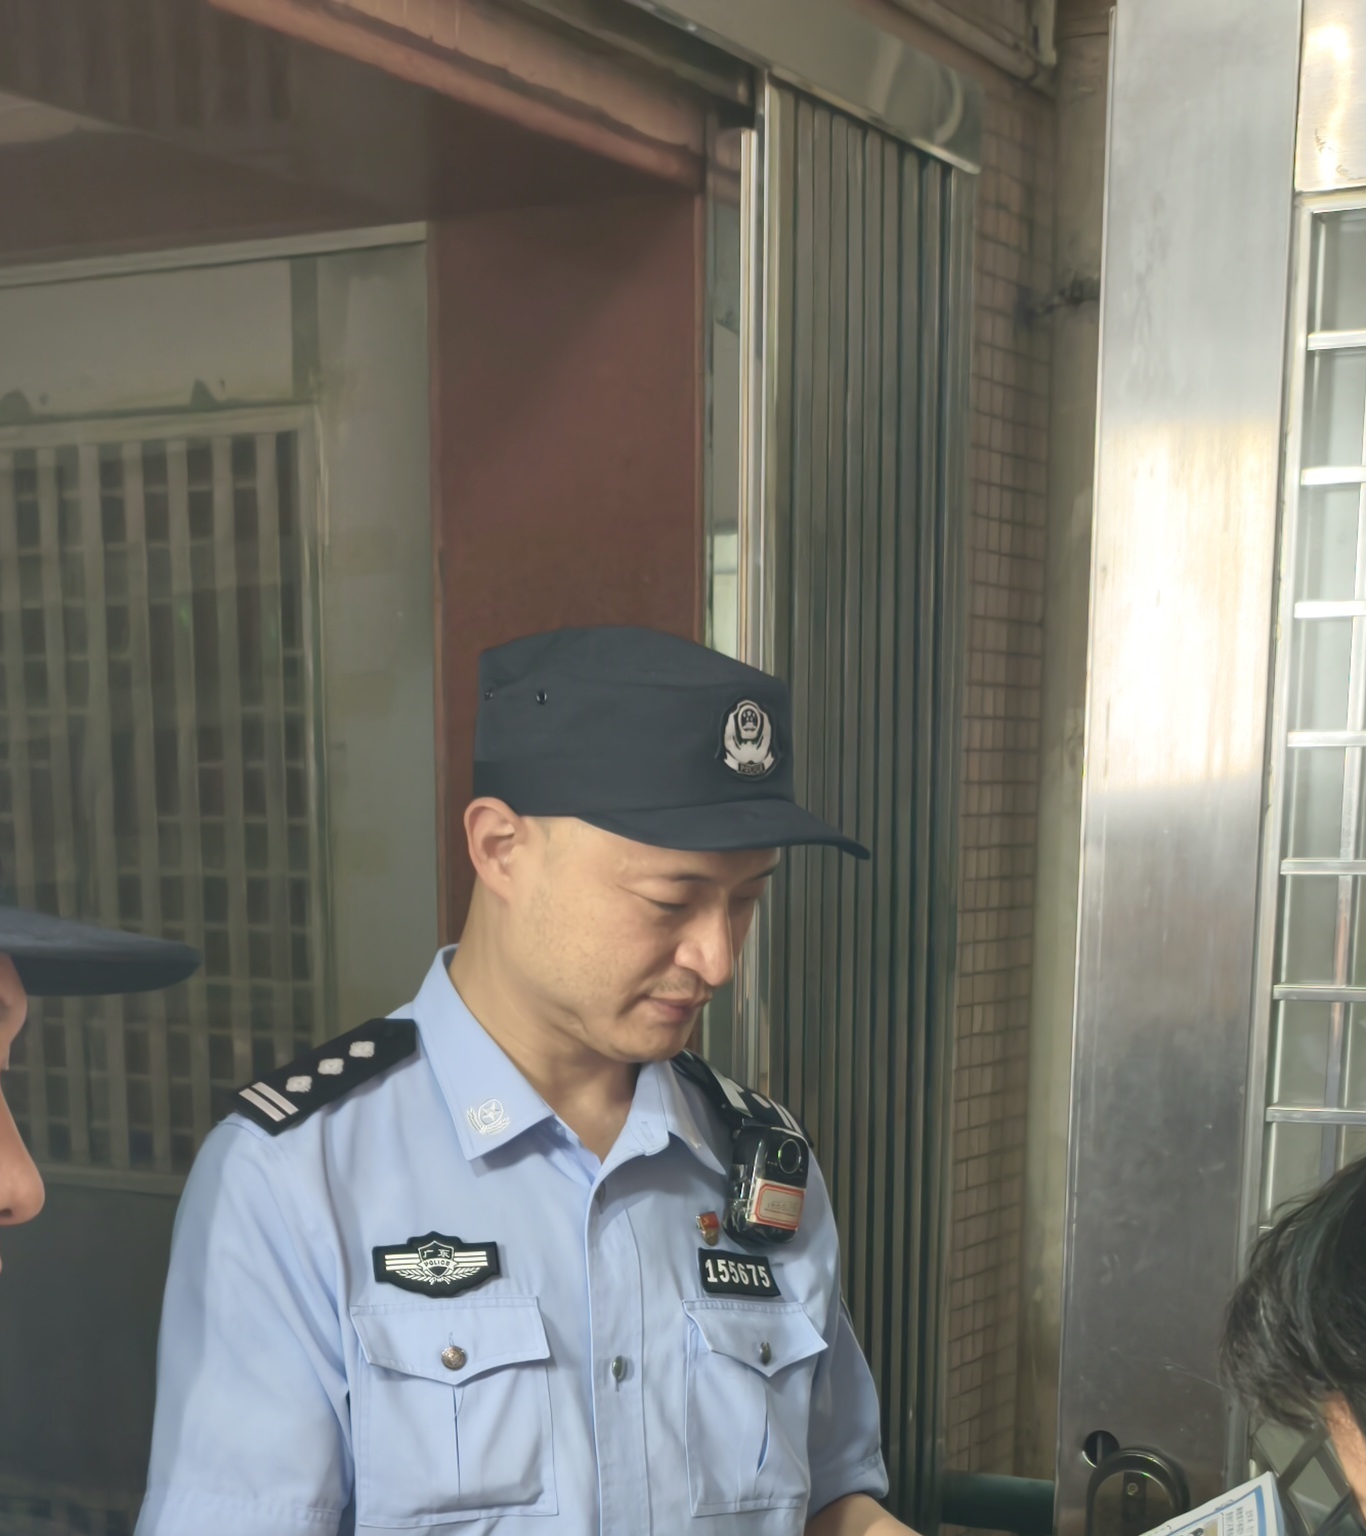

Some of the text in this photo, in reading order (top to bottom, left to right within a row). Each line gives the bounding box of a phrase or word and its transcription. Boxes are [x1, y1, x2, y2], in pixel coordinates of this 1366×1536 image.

[423, 1248, 450, 1258] 广东
[424, 1259, 450, 1267] POLICE
[705, 1257, 771, 1288] 155675
